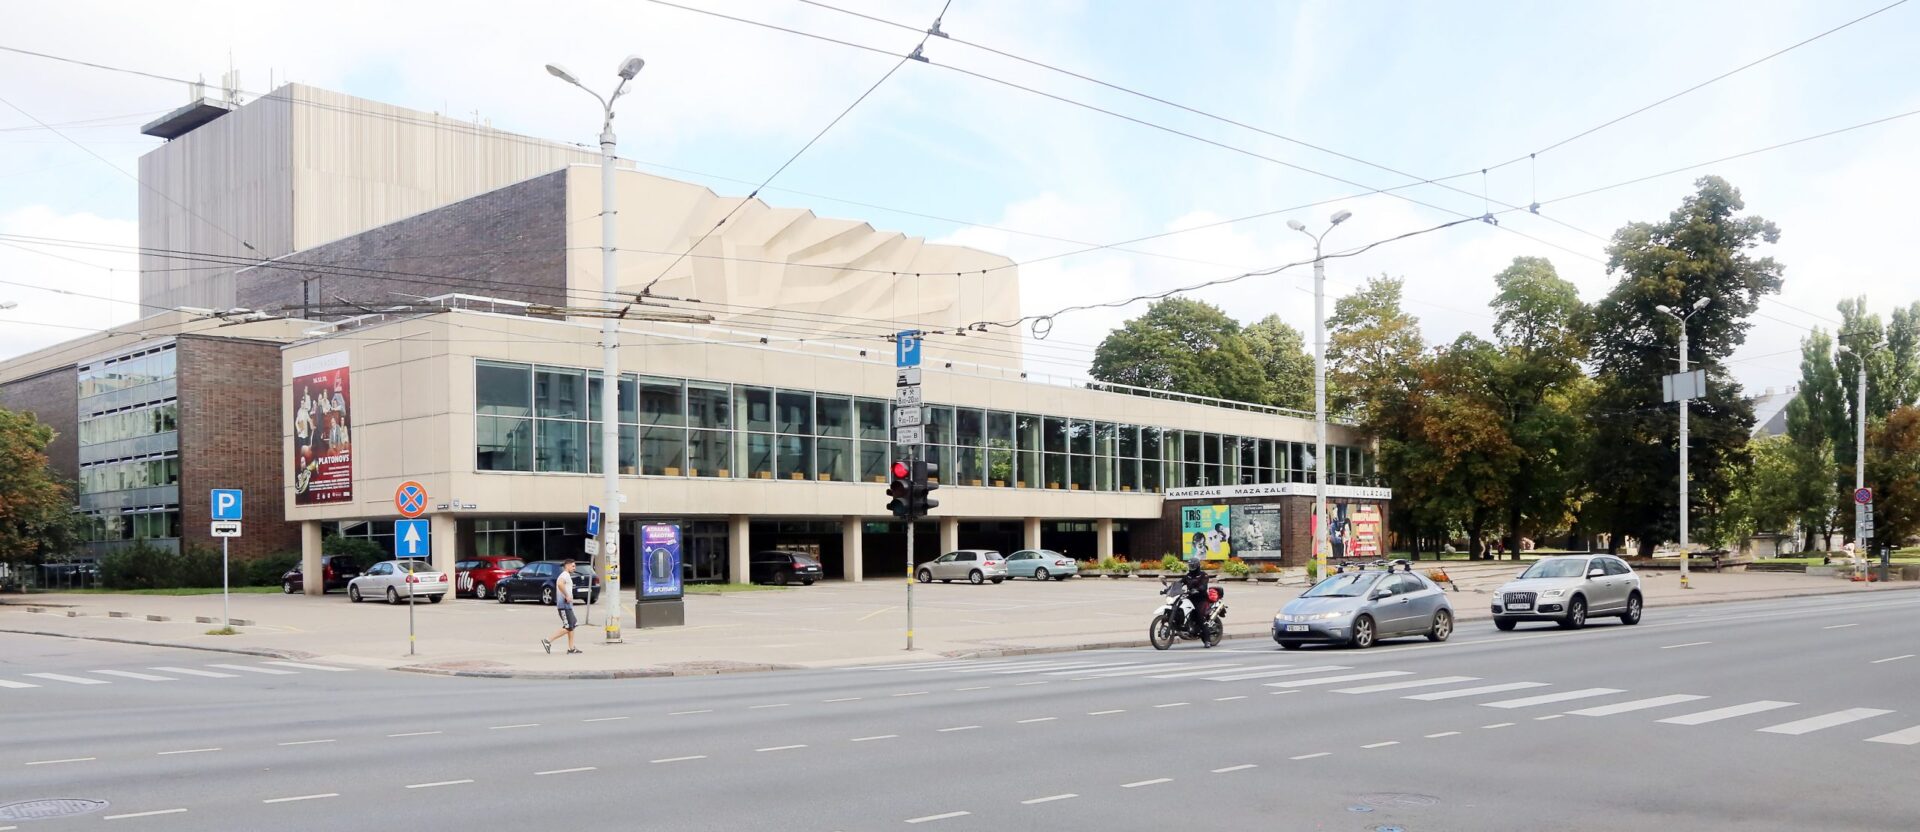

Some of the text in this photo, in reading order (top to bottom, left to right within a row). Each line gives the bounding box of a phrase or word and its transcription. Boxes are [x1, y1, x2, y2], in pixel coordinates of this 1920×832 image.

[901, 336, 915, 363] P
[318, 455, 350, 465] PLATONOVS
[218, 493, 235, 516] P
[589, 509, 597, 530] P
[457, 571, 474, 591] illy
